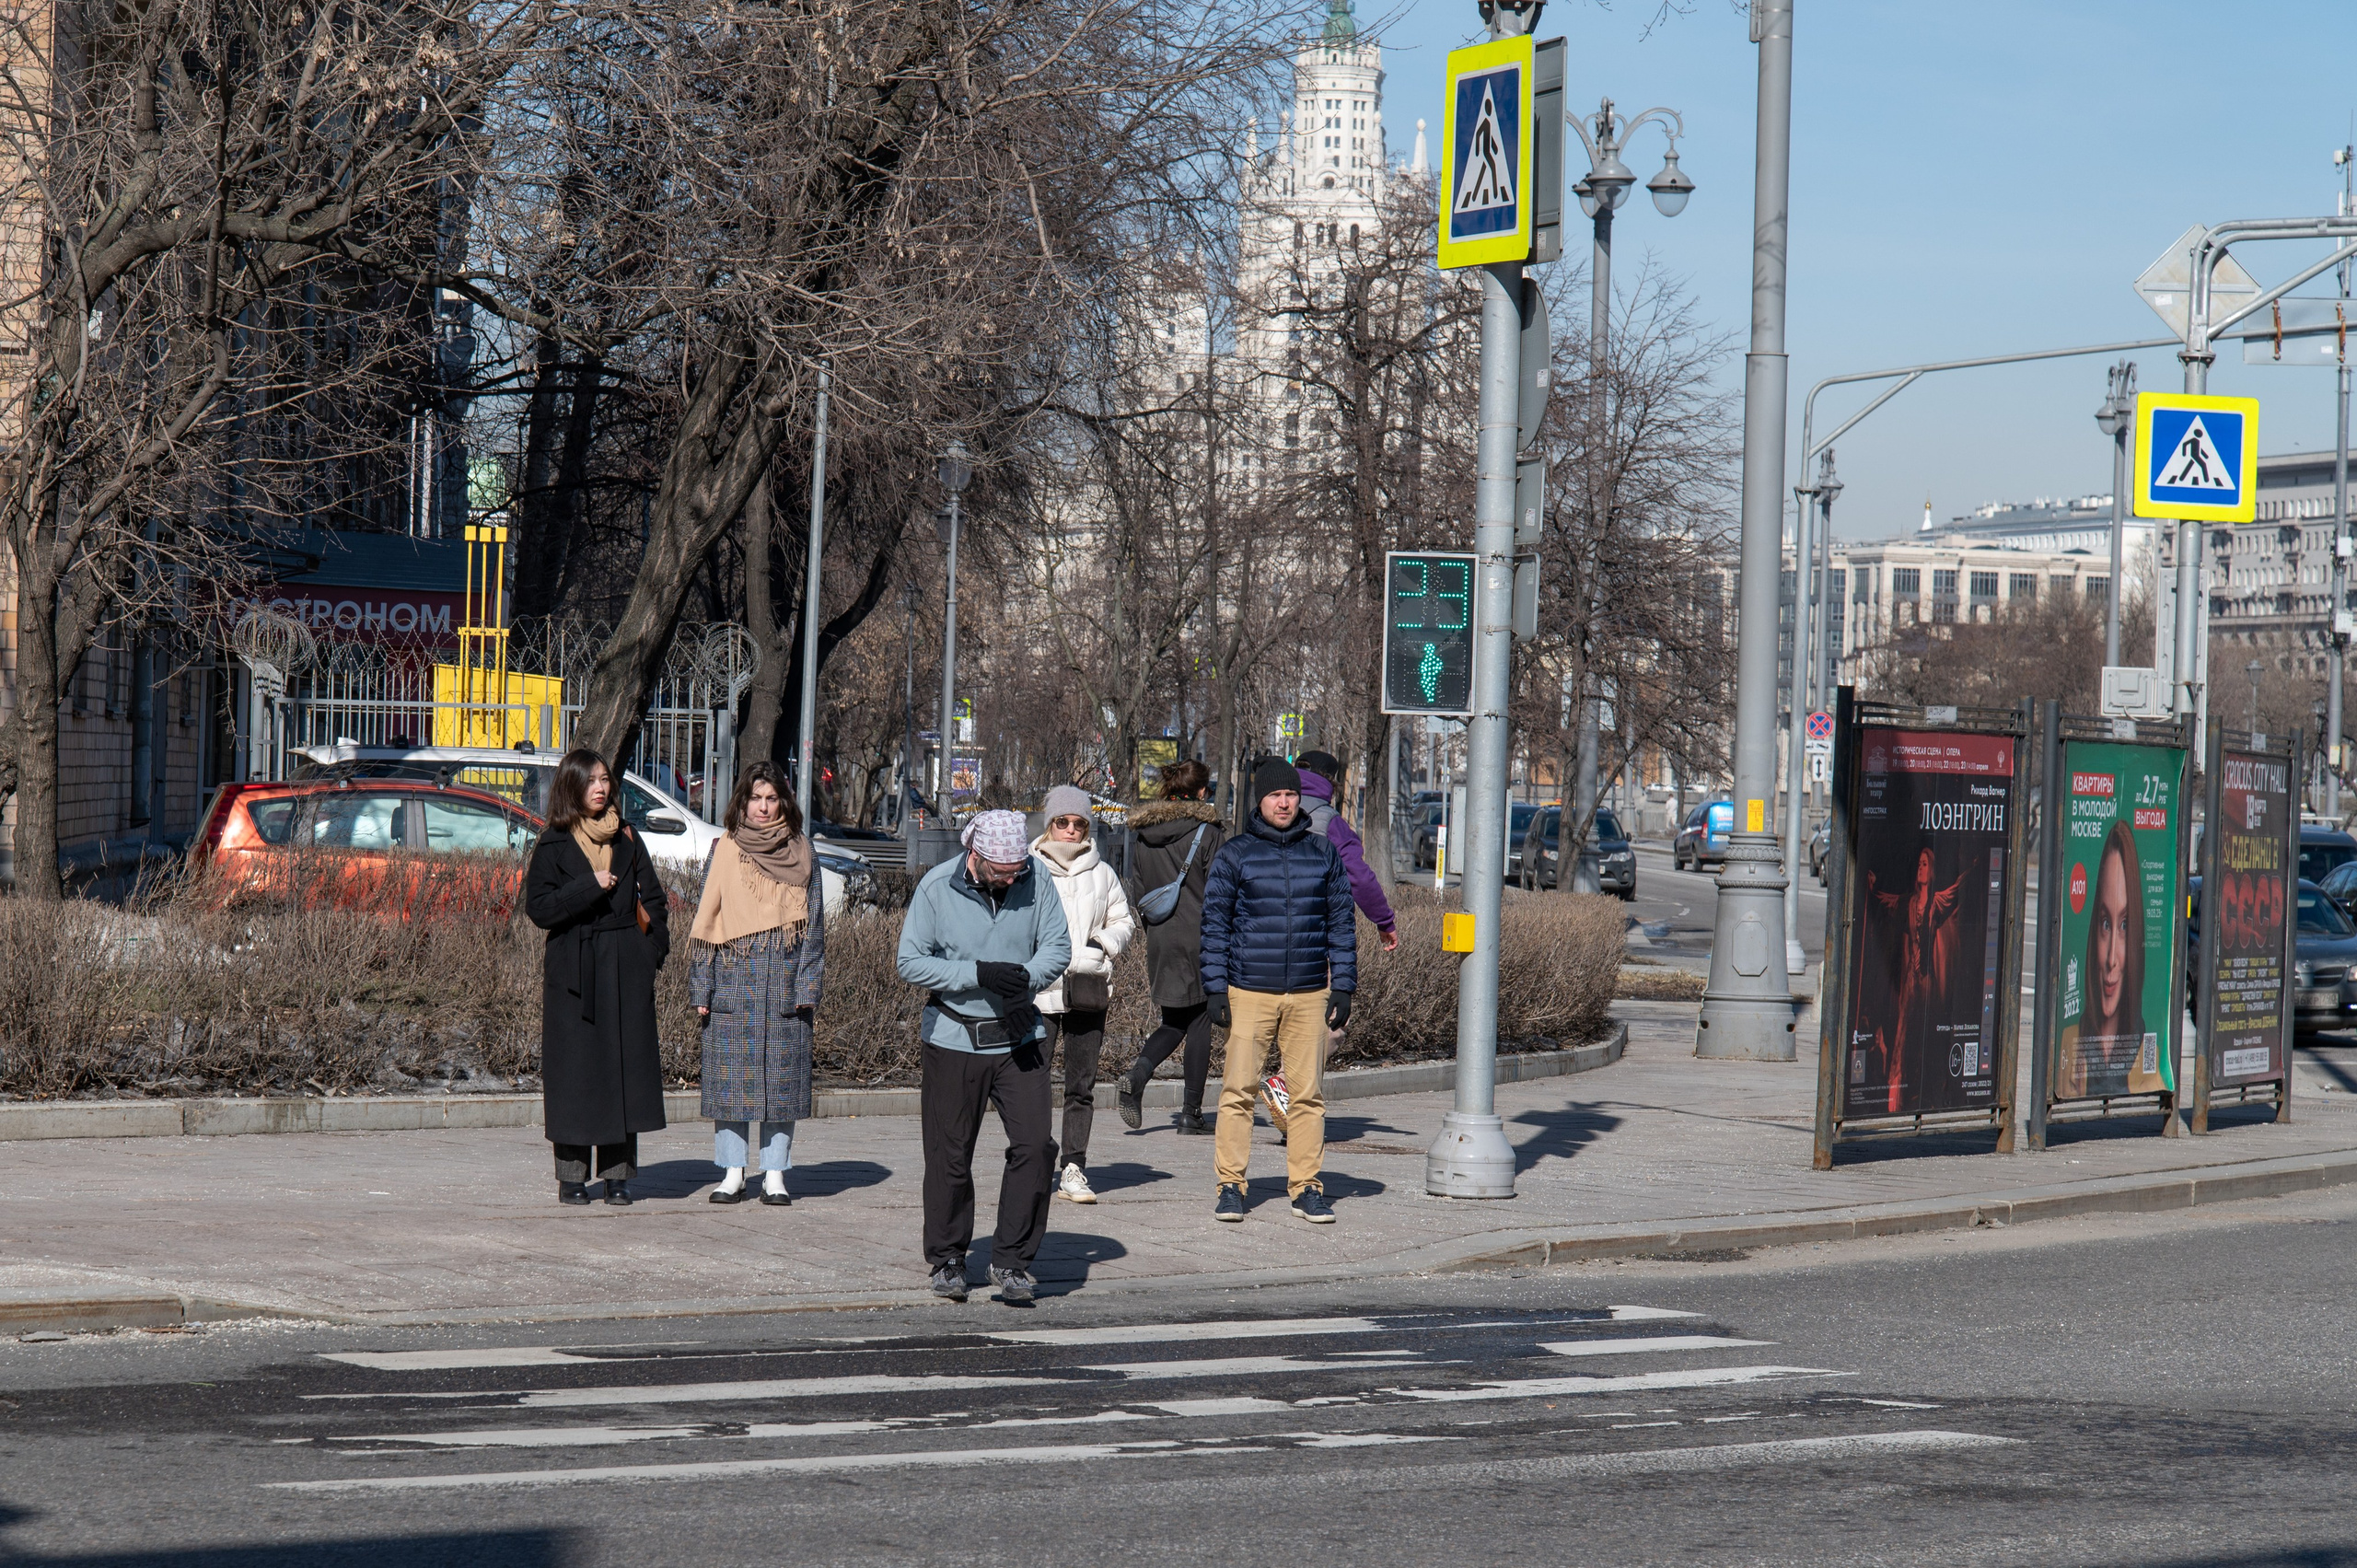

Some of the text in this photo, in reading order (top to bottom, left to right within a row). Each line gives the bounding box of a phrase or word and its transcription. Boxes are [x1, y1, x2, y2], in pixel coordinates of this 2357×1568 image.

[1892, 746, 1961, 757] ИСТОРИЧЕСКАЯ СЦЕНА ОПЕРА
[2073, 775, 2114, 794] КВАРТИРЫ
[2225, 760, 2286, 794] CROCUS CITY HALL
[1971, 784, 2006, 798] Рихард Вагнер
[2142, 774, 2160, 807] 2,7
[1920, 802, 2004, 831] ЛОЭНГРИН
[2072, 798, 2117, 819] В МОЛОДОЙ
[2247, 795, 2255, 830] 19
[2072, 821, 2102, 837] МОСКВЕ
[2136, 811, 2165, 828] ВЫГОДА
[2232, 835, 2279, 873] СДЕЛАНО В
[2221, 873, 2283, 948] СССР
[1951, 1053, 1962, 1068] 16+
